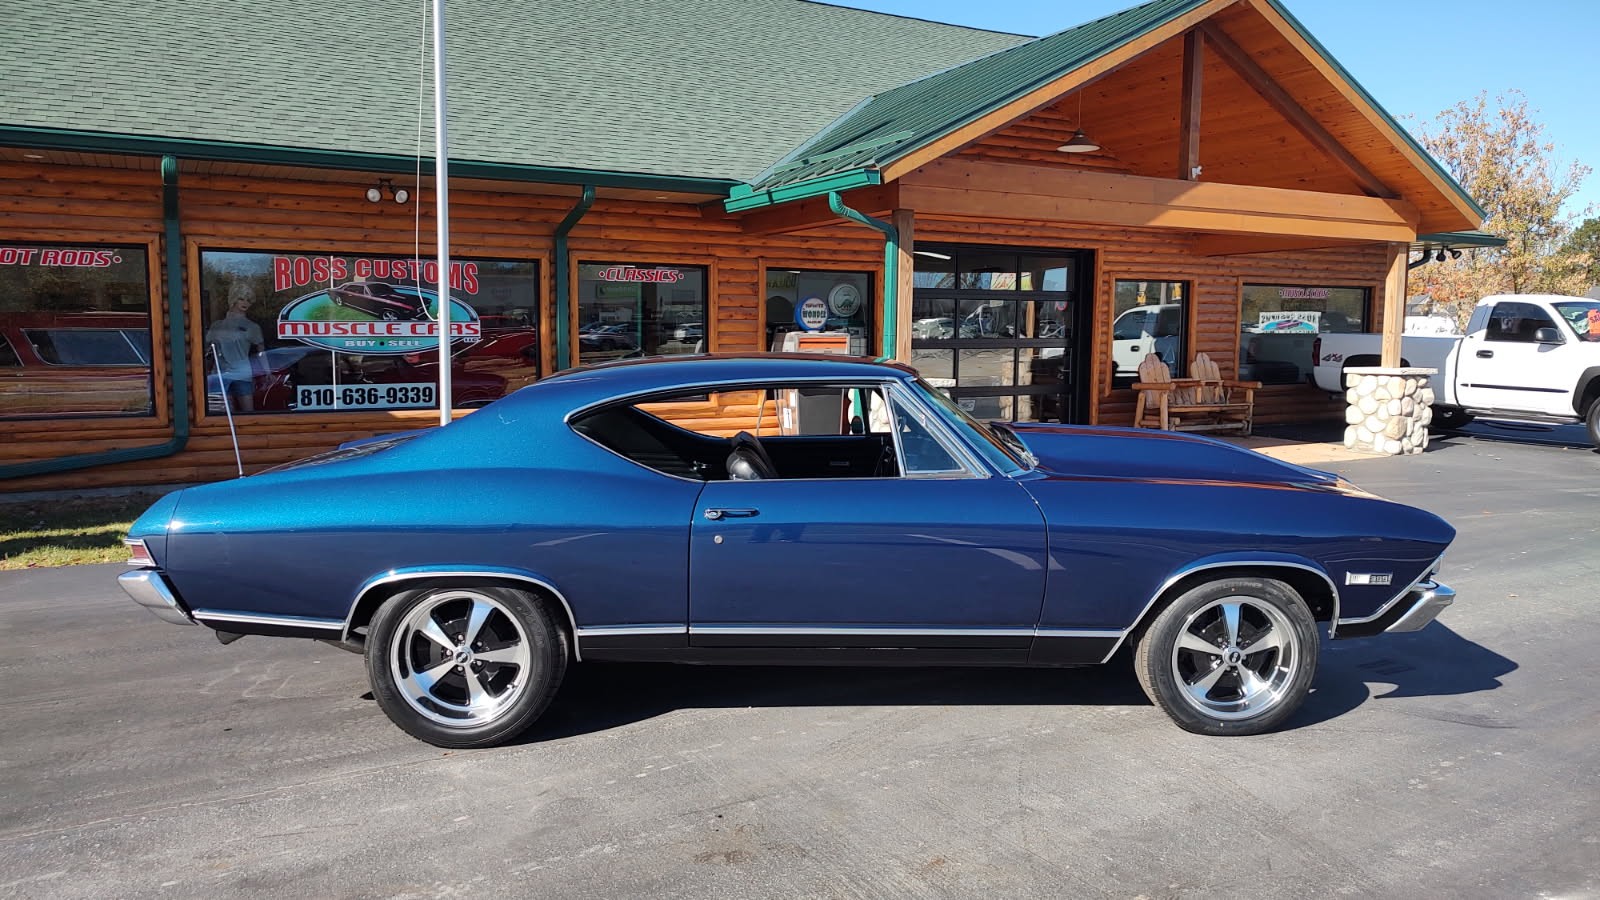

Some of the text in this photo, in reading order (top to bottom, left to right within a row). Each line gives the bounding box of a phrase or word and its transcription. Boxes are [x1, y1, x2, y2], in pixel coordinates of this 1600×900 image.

[0, 248, 38, 265] OT
[274, 256, 479, 295] ROSS CUSTOMS
[605, 267, 679, 283] CLASSICS
[278, 322, 402, 336] MUSCLE
[300, 386, 433, 406] 810-636-9339
